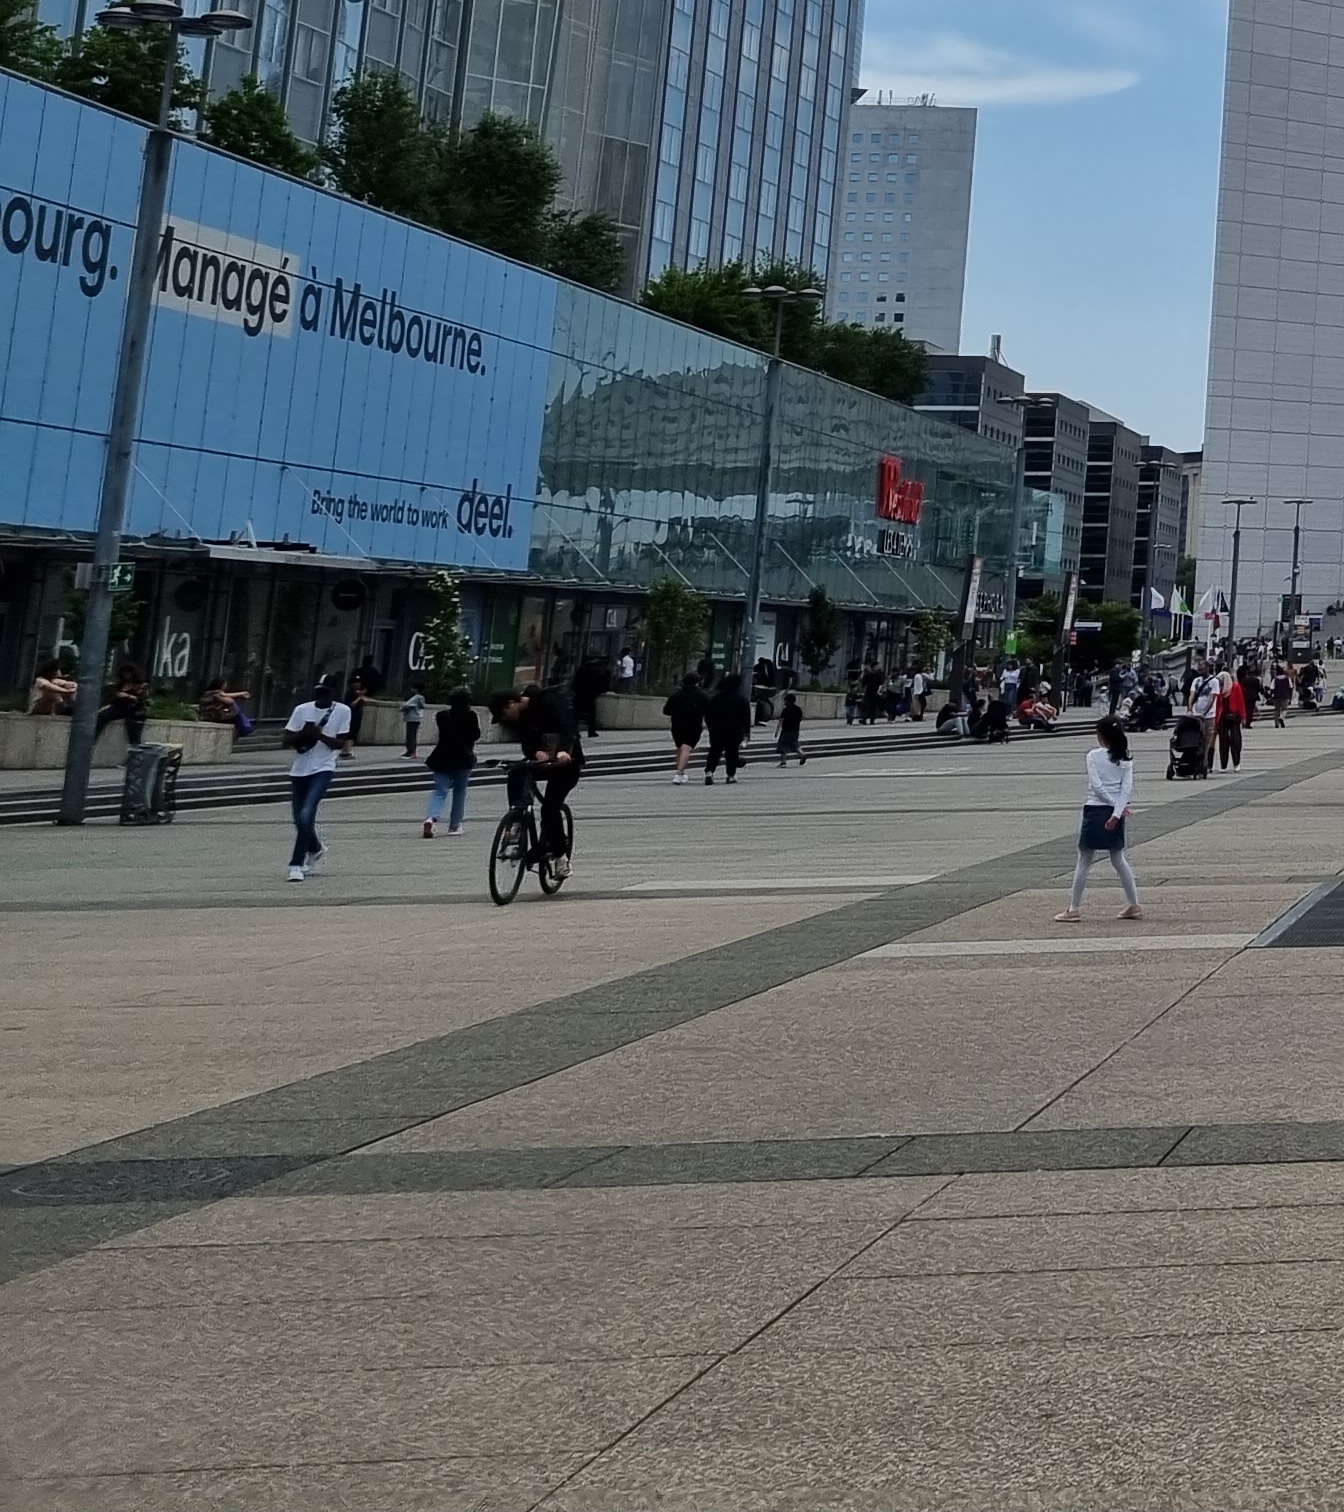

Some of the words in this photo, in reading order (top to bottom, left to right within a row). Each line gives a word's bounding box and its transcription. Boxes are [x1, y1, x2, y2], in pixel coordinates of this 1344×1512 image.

[0, 196, 118, 298] ourg.
[300, 266, 322, 332] à
[330, 277, 486, 376] Melbourne.
[311, 489, 345, 524] Bring
[347, 493, 368, 521] the
[370, 499, 406, 524] world
[407, 503, 420, 526] to
[421, 505, 449, 530] work
[457, 478, 513, 539] deel.
